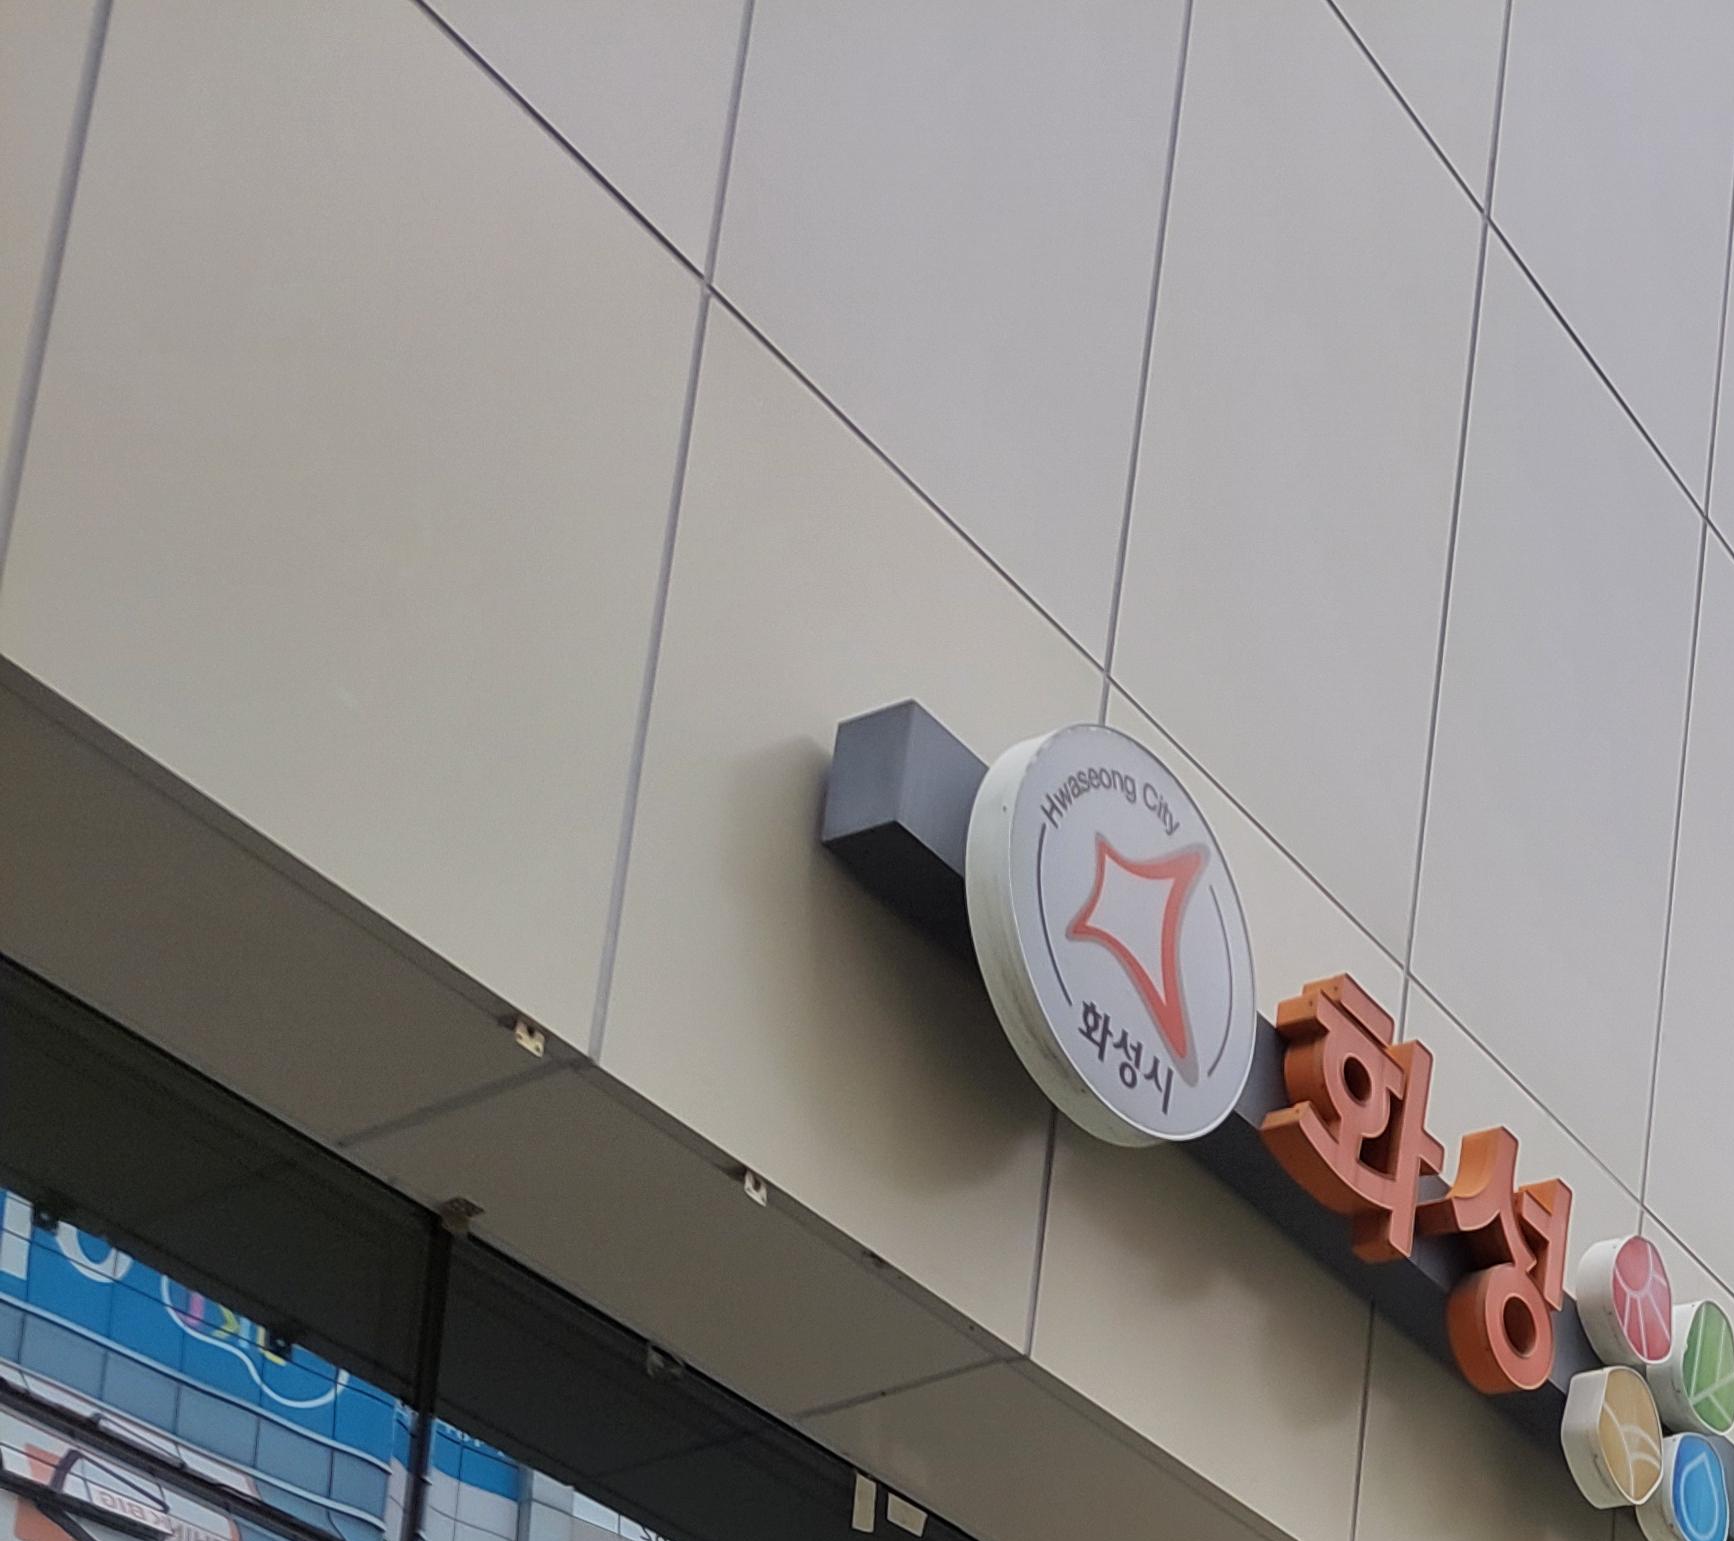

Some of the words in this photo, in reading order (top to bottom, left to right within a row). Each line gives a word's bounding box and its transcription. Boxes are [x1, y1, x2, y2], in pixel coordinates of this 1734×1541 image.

[1040, 764, 1136, 831] Hwaseong
[1144, 782, 1180, 836] City
[1078, 1000, 1174, 1115] 화성시
[1262, 972, 1573, 1392] 화성
